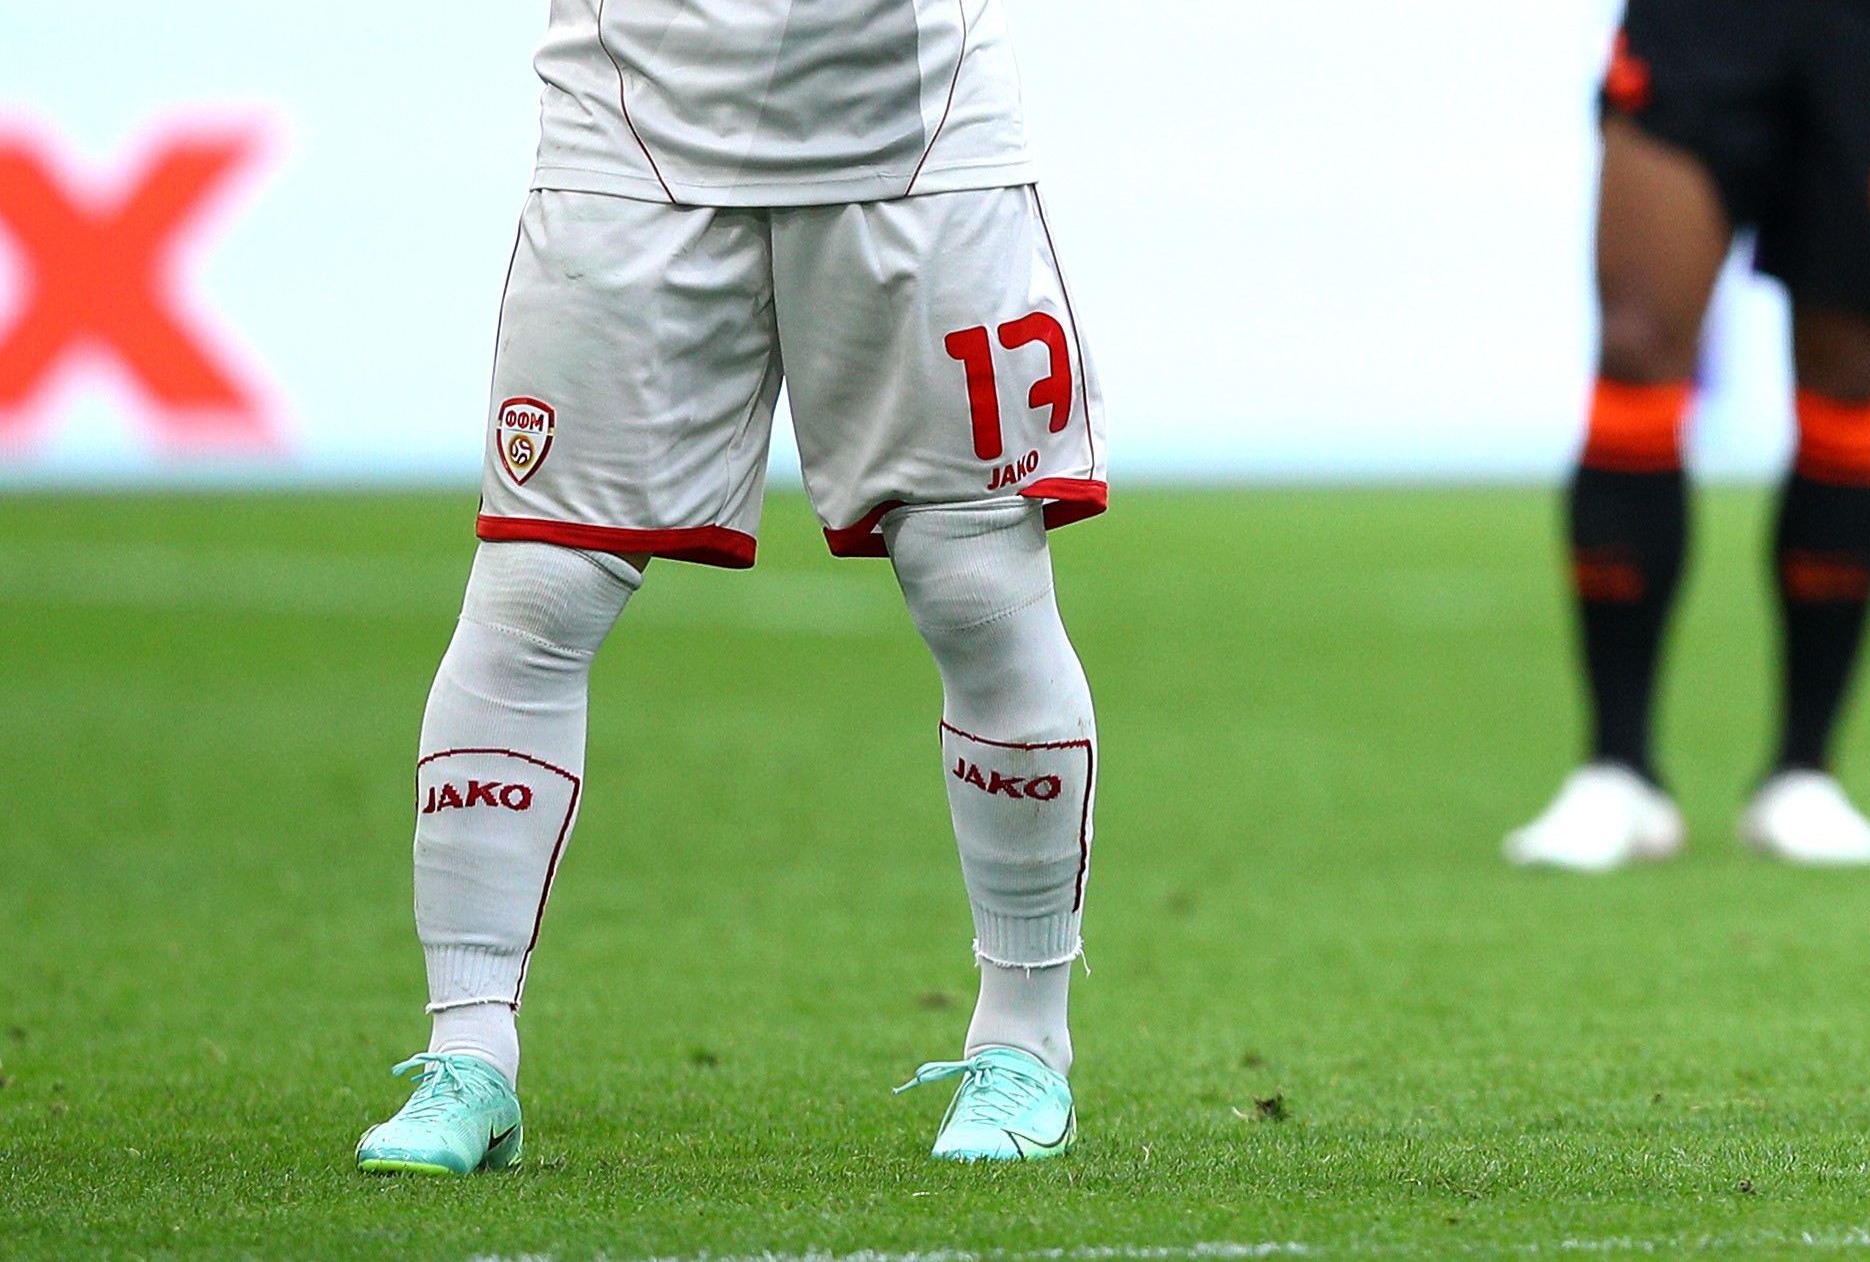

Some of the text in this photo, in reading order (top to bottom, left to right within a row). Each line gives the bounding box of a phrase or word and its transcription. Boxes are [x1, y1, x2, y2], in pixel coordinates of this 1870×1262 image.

[944, 311, 1073, 461] 17
[987, 449, 1040, 490] JAKO
[422, 780, 533, 814] JAKO
[952, 756, 1062, 802] JAKO
